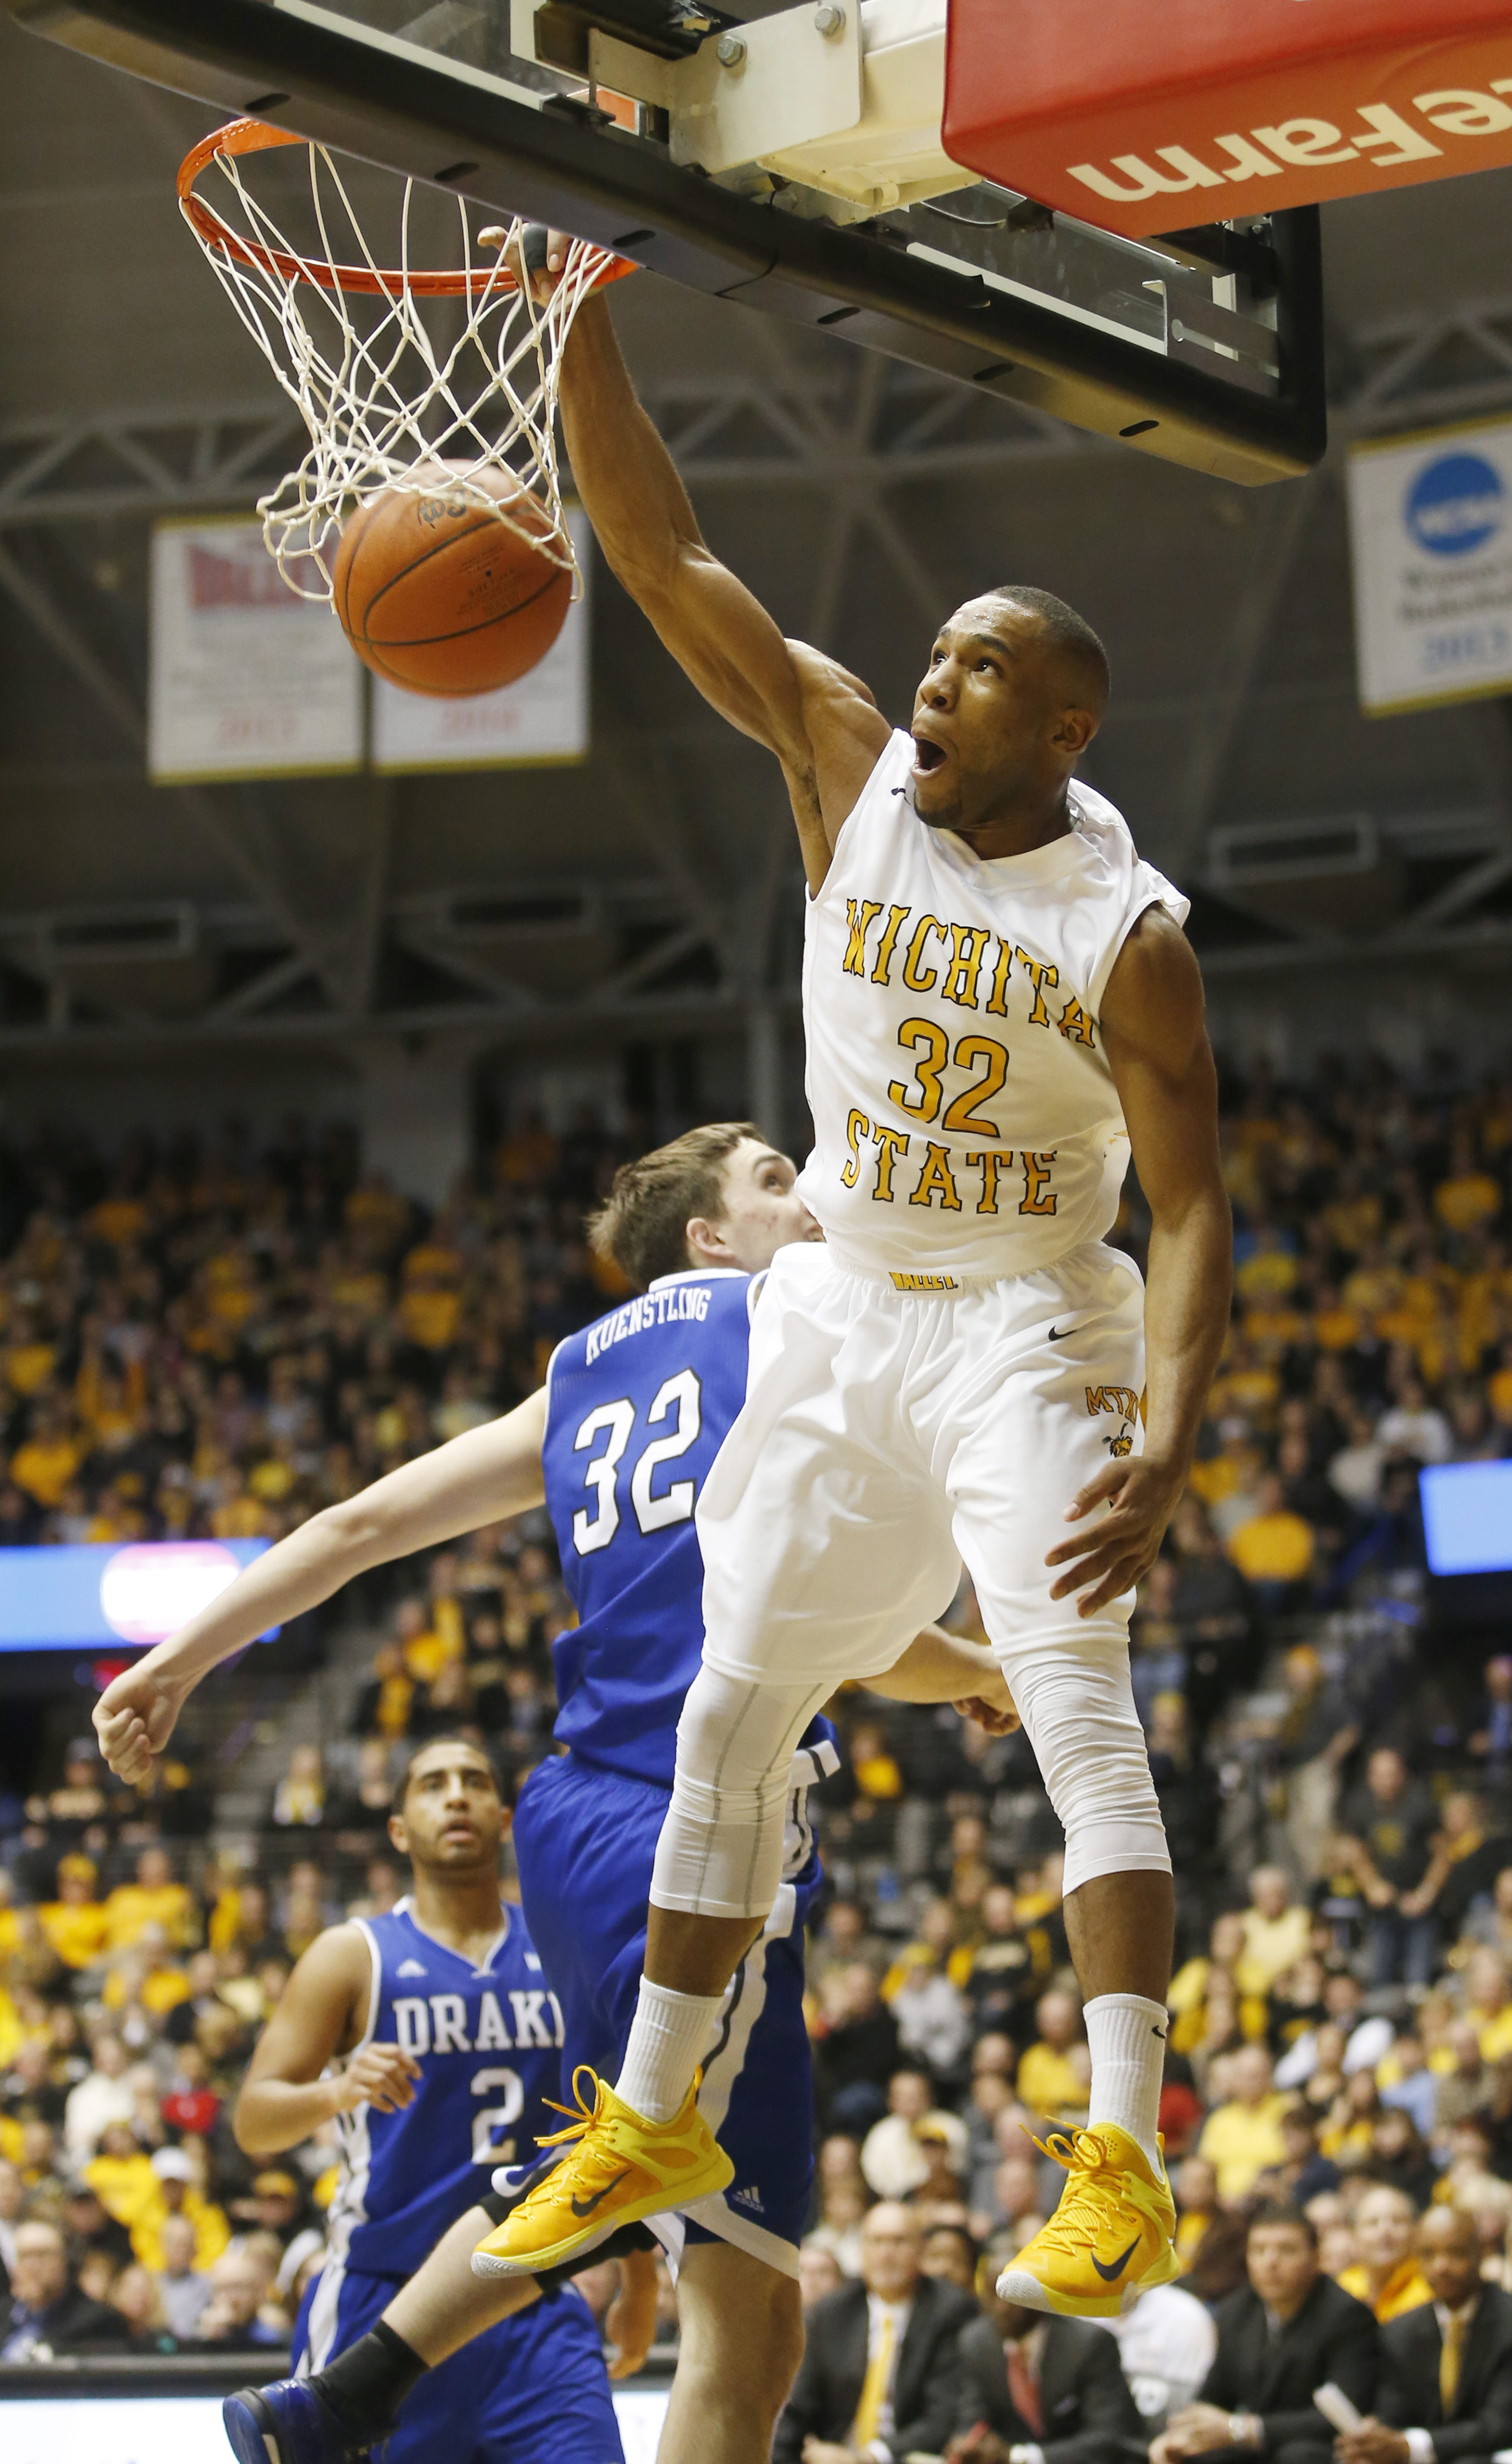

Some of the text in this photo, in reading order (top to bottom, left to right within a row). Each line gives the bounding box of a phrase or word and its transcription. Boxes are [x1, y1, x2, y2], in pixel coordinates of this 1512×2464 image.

[843, 898, 1096, 1049] WICHITA
[887, 1017, 1010, 1138] 32
[840, 1109, 1058, 1215] STATE
[585, 1287, 712, 1366] KUENSTLING
[573, 1366, 702, 1557] 32
[471, 2067, 525, 2164] 2
